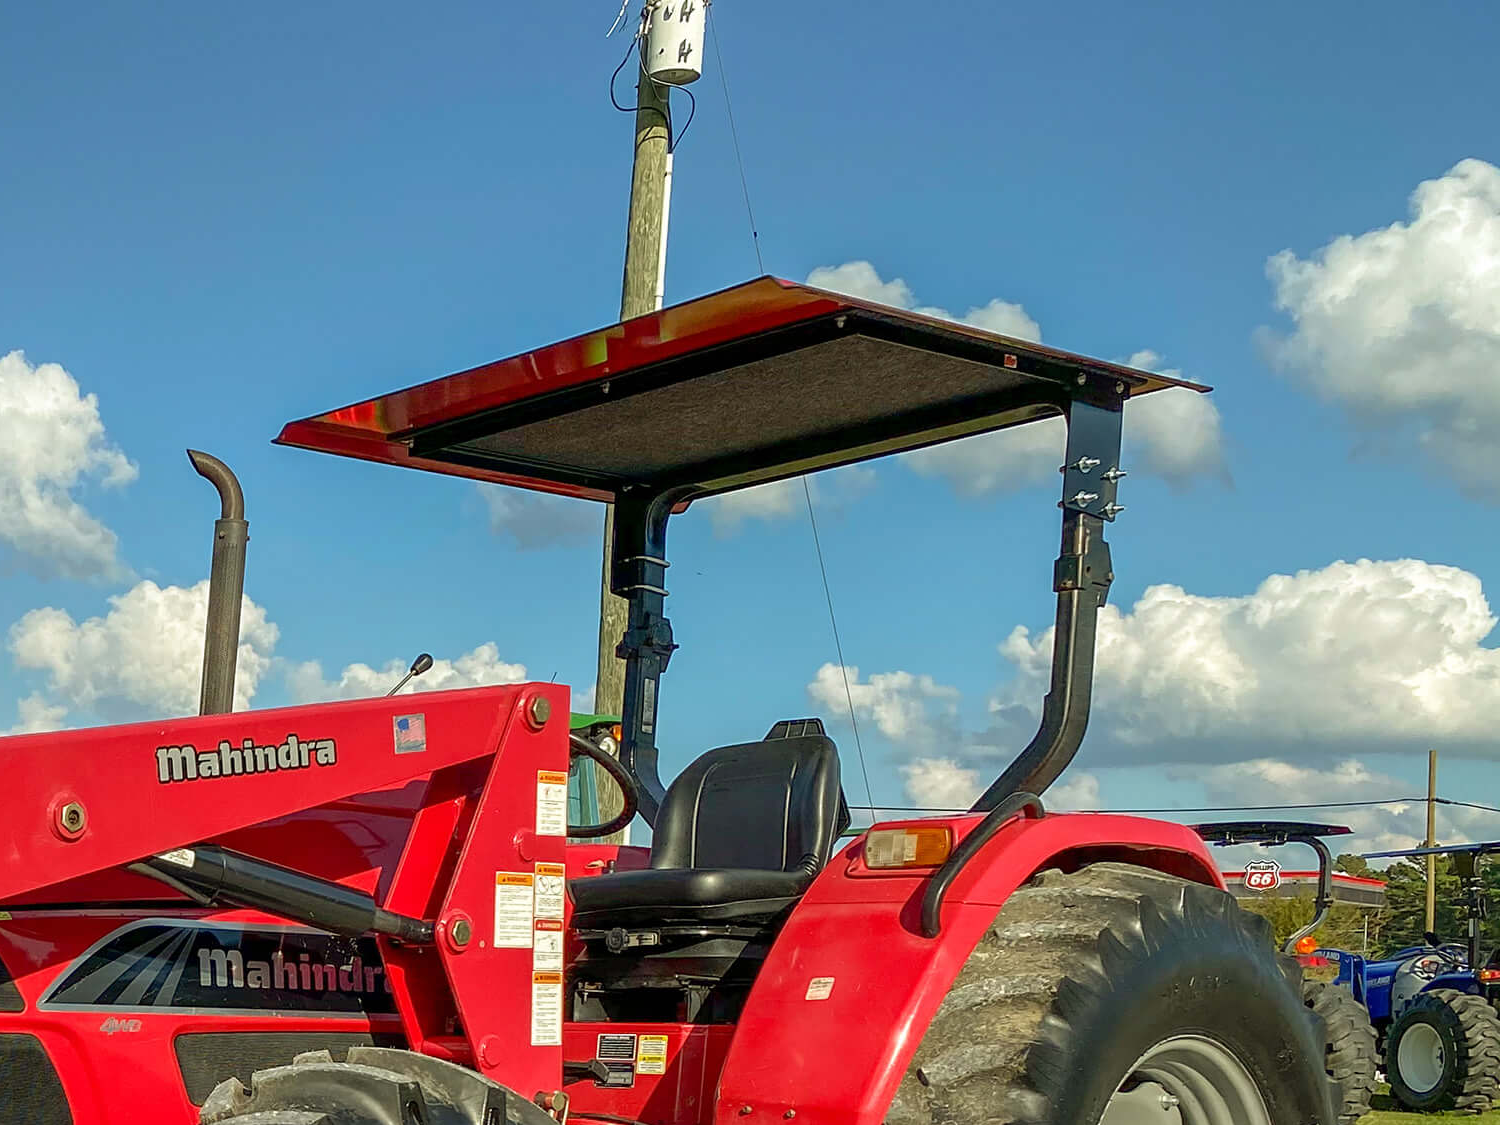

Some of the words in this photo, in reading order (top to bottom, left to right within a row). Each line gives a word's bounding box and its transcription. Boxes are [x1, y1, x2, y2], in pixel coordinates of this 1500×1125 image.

[156, 734, 338, 784] Mahindra
[1250, 873, 1273, 886] 66
[100, 1017, 142, 1035] 4WD
